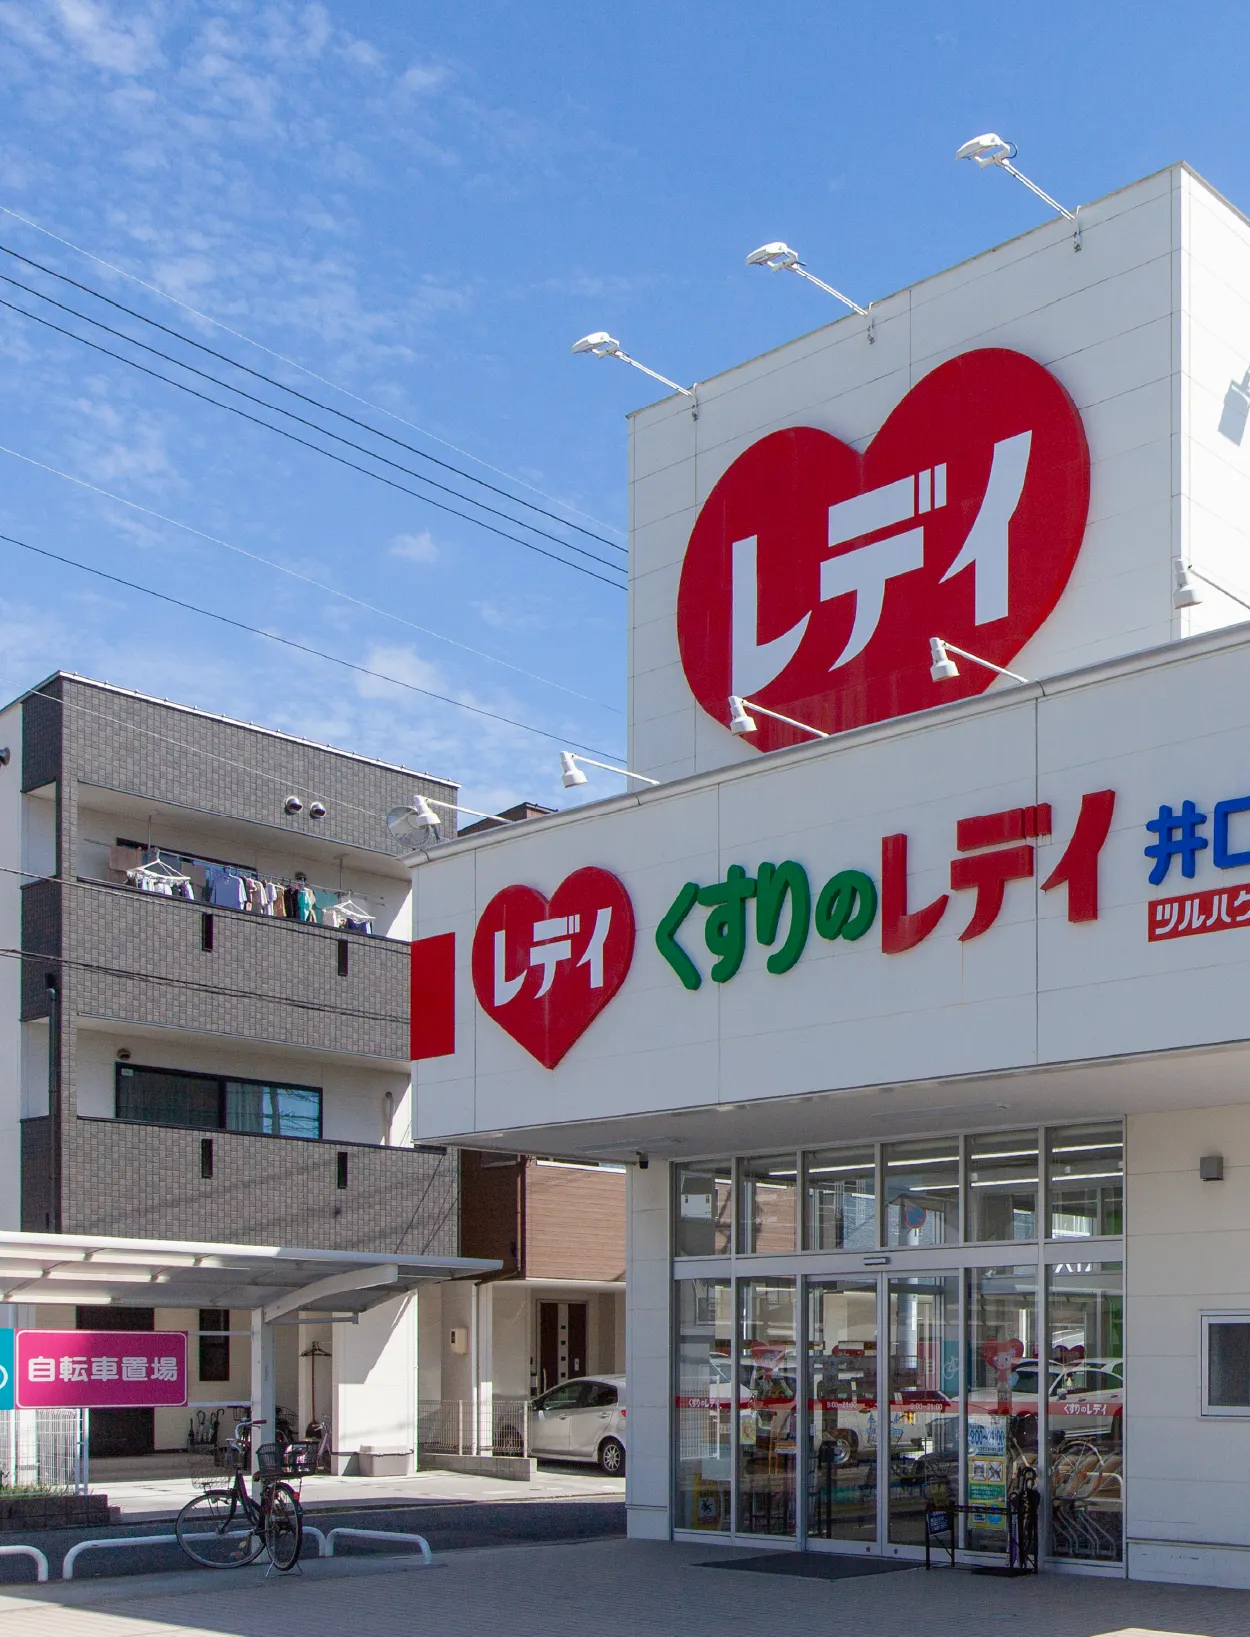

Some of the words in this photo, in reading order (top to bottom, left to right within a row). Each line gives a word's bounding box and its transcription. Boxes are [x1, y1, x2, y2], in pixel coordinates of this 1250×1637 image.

[732, 430, 1032, 701] レディ
[494, 906, 612, 1007] レディ
[28, 1356, 177, 1382] 自転車置場
[1063, 1403, 1107, 1416] くすりのレディ
